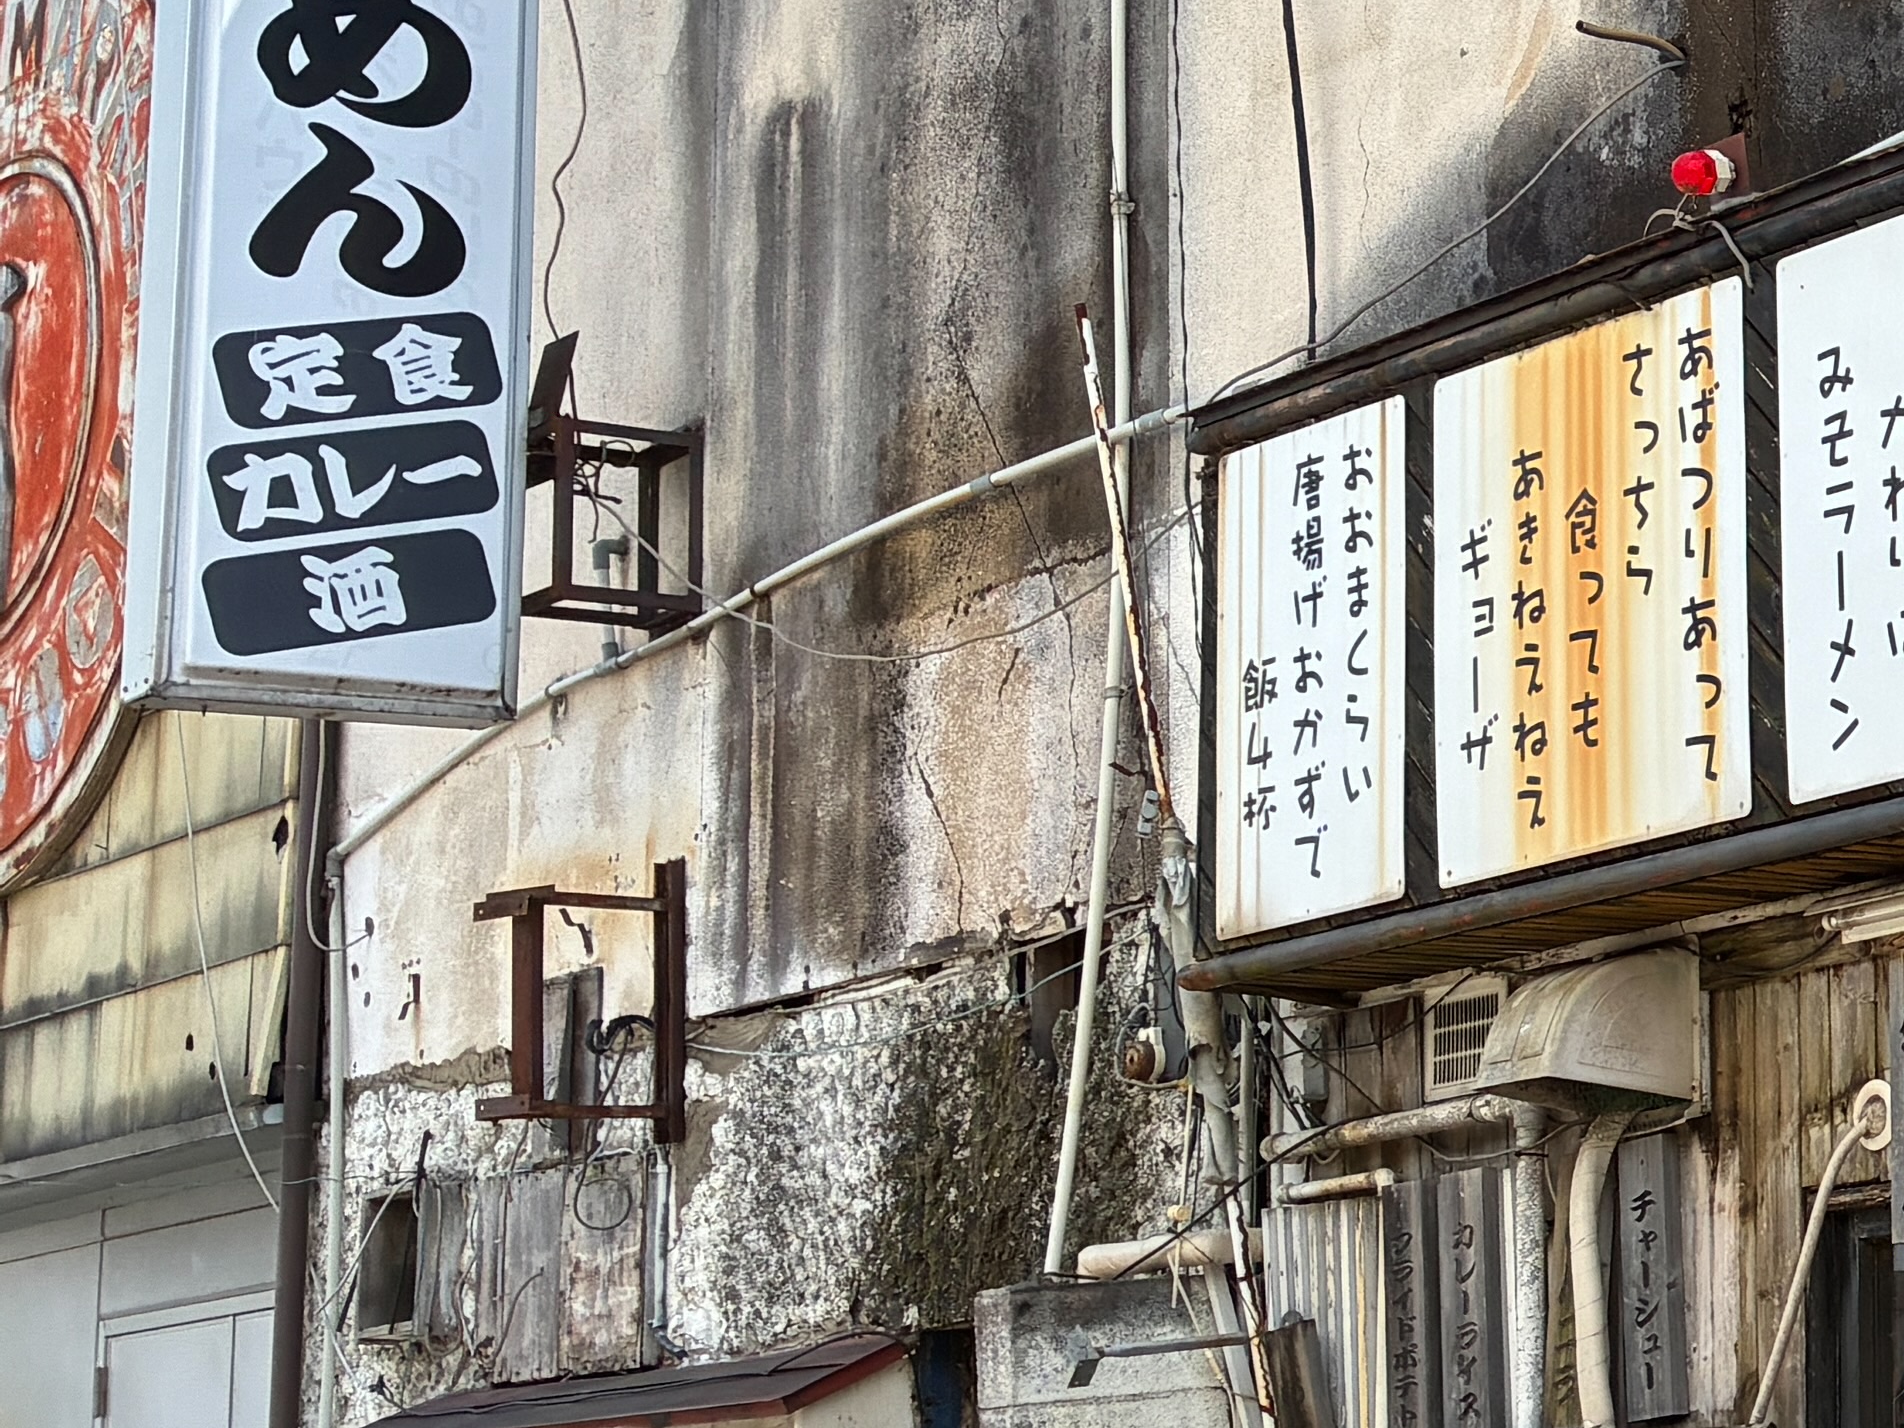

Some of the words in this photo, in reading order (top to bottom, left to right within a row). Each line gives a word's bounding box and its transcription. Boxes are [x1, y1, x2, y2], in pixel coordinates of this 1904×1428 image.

[222, 444, 482, 532] カレー
[248, 323, 474, 420] 定食
[301, 546, 407, 633] 酒
[1291, 459, 1330, 879] 唐揚げおかずで
[1342, 443, 1376, 805] おおまくらい
[1460, 524, 1495, 773] ギョーザ
[1510, 446, 1549, 830] あきねえねえ
[1564, 488, 1603, 751] 食っても
[1816, 345, 1861, 751] みそラーメン
[1453, 1222, 1482, 1421] カレーライス
[1630, 1190, 1663, 1390] チャーシュー
